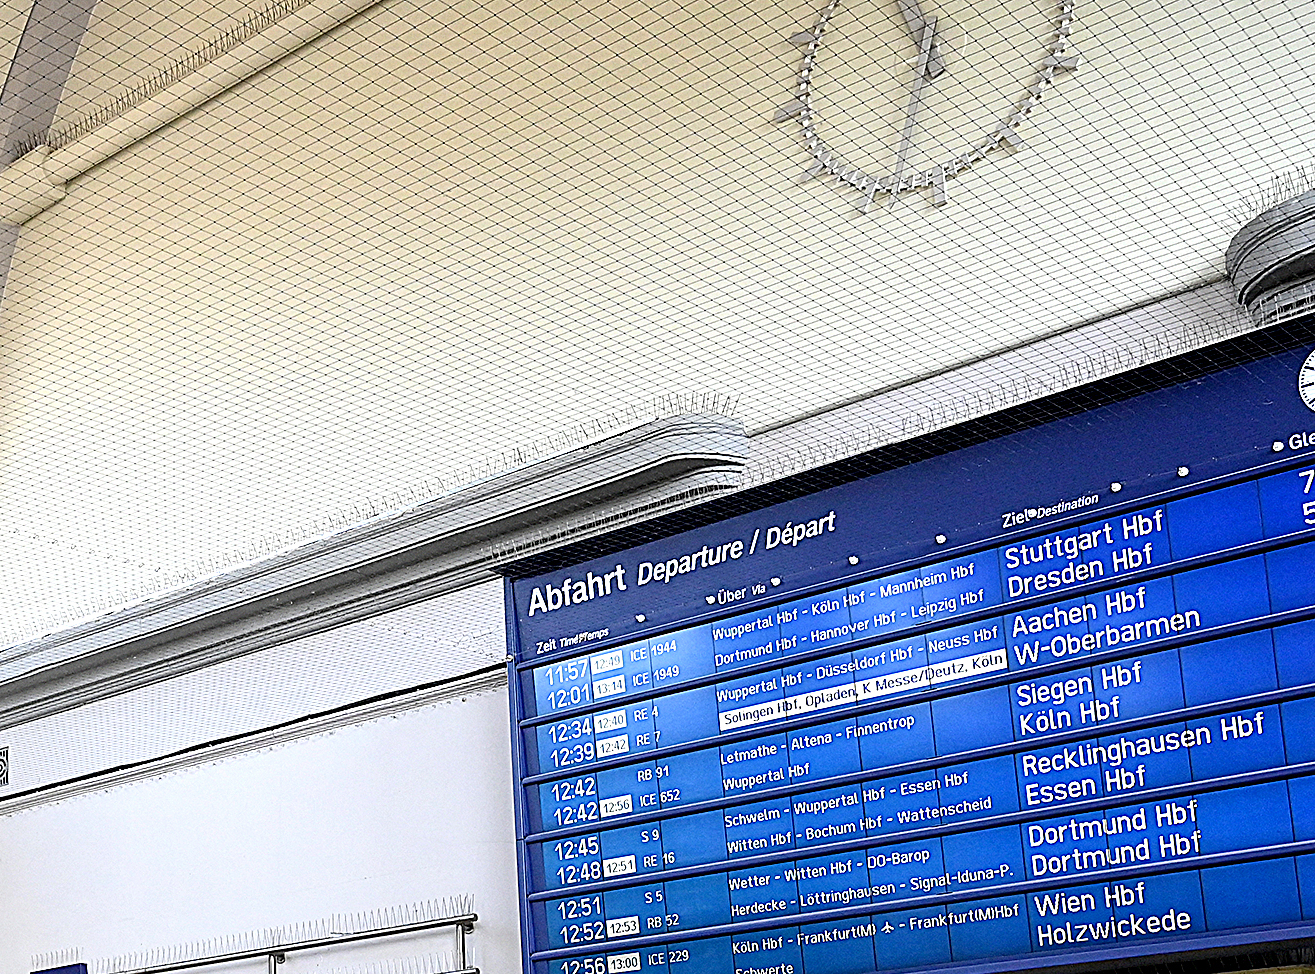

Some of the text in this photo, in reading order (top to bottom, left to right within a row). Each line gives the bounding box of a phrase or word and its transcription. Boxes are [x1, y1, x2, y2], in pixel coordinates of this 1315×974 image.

[529, 511, 835, 616] Abfahrt Departure Départ
[1002, 495, 1098, 528] Ziel Destination
[536, 639, 556, 654] Zeit
[545, 510, 1162, 685] 11:57 12:49 ICE 1944 Wuppertal Hbf Köln Hbf Mannheim Hbf Stuttgart Hbf
[548, 543, 1152, 709] 12:01 13:14 ICE 1949 Dortmund Hbf Hannover Hbf Leipzig Hbf Dresden Hbf
[718, 585, 765, 604] Über Via
[549, 587, 1145, 743] 12:34 12:40 RE Wuppertal Hbf Düsseldorf Hbf Neuss Hbf Aachen Hbf
[551, 611, 1200, 767] 12:39 12:42 RE 7 Solingen Hbf, Opladen, K Messe/Deutz, Köln W-Oberbarmen
[552, 661, 1141, 801] 12:42 RB 91 Letmathe Altena Finnentrop Siegen Hbf
[554, 696, 1119, 825] 12:42 12:56 ICE 652 Wuppertal Hbf Köln Hbf
[555, 712, 1263, 860] 12:45 Schwelm Wuppertal Hbf Essen Hbf Recklinghausen Hbf
[557, 765, 1145, 884] 12:48 12:51 RE 16 Witten Hbf Bochum Hbf Wattenscheid Essen Hbf
[558, 800, 1197, 919] 12:51 5 Wetter Witten Hbf DO-Barop Dortmund Hbf
[560, 830, 1201, 943] 12:52 12:53 RB 52 Herdecke Löttringhausen Signal-Iduna-P. Dortmund Hbf
[610, 956, 638, 970] 13:00
[649, 953, 665, 965] ICE
[669, 950, 688, 962] 229
[733, 941, 758, 954] Köln
[763, 937, 783, 951] Hbf
[797, 924, 876, 945] Frankfurt(M)
[1035, 894, 1094, 916] Wien
[1105, 882, 1144, 907] Hbf
[1038, 909, 1190, 946] Holzwickede
